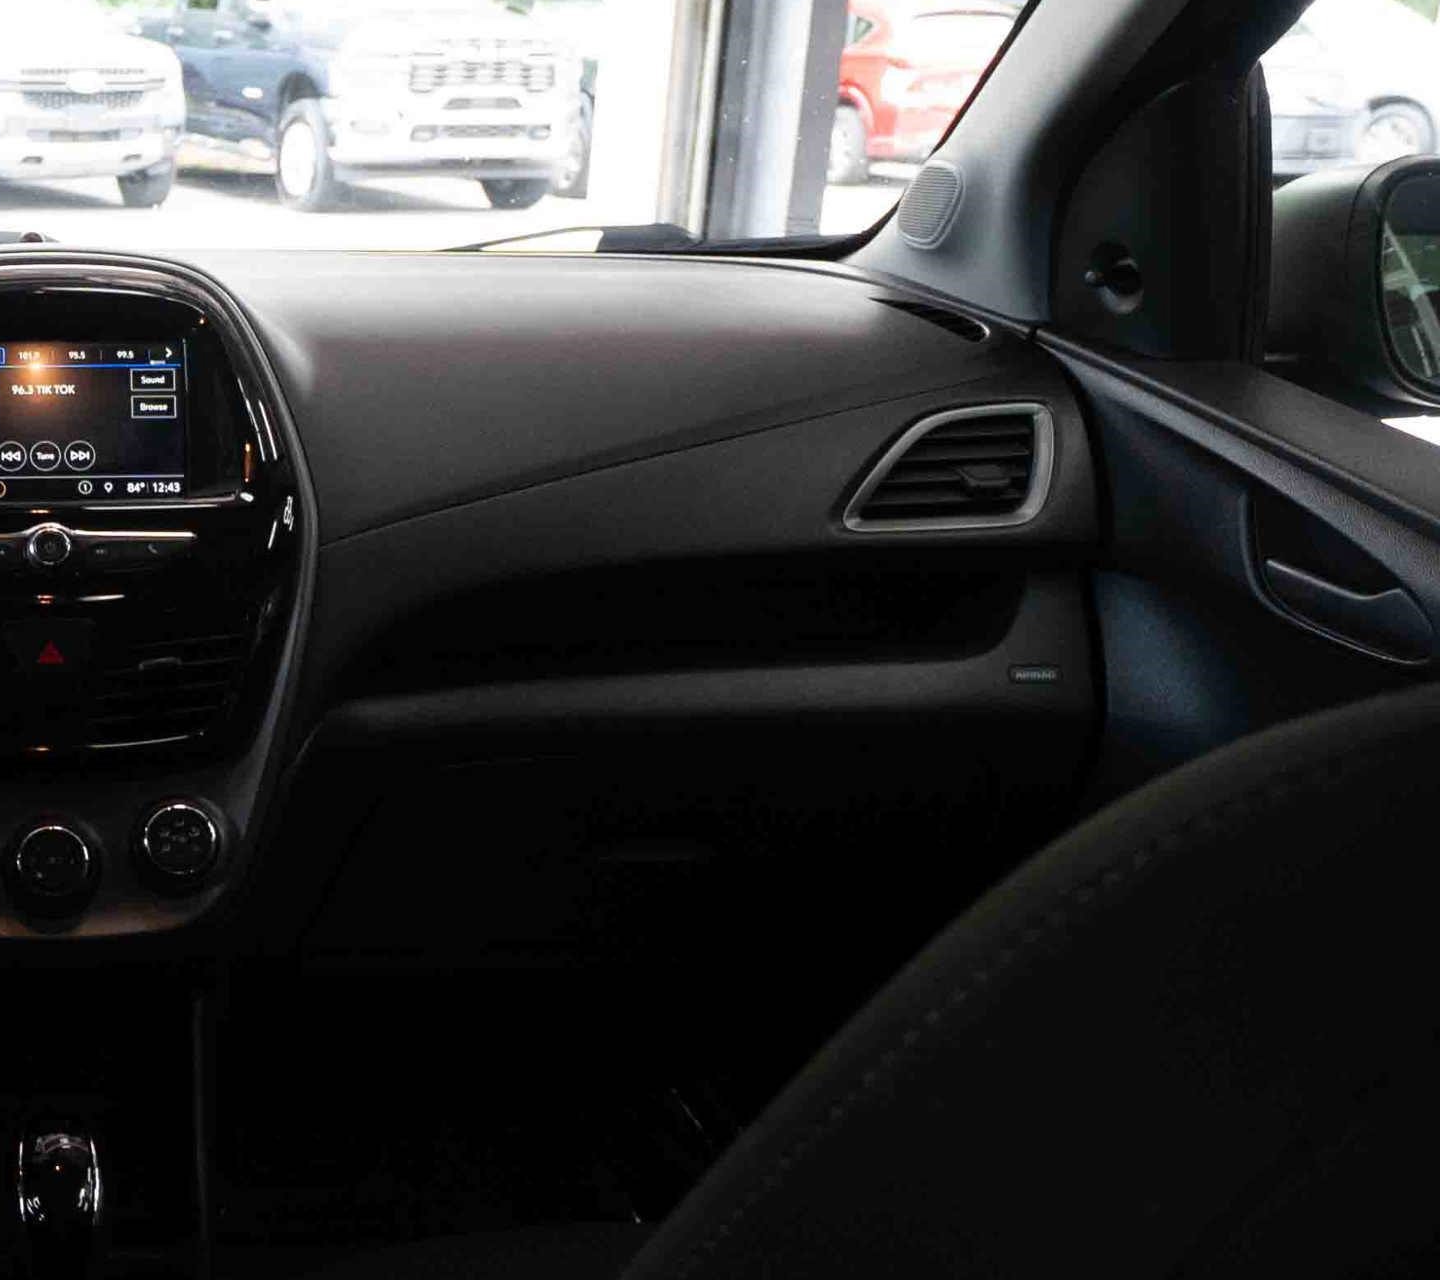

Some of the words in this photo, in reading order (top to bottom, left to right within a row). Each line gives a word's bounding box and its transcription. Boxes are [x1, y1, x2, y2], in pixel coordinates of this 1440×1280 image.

[140, 375, 166, 385] Sound
[35, 384, 53, 396] TIK
[54, 384, 76, 396] TOK
[140, 402, 169, 412] Browse
[152, 482, 181, 494] 12:43
